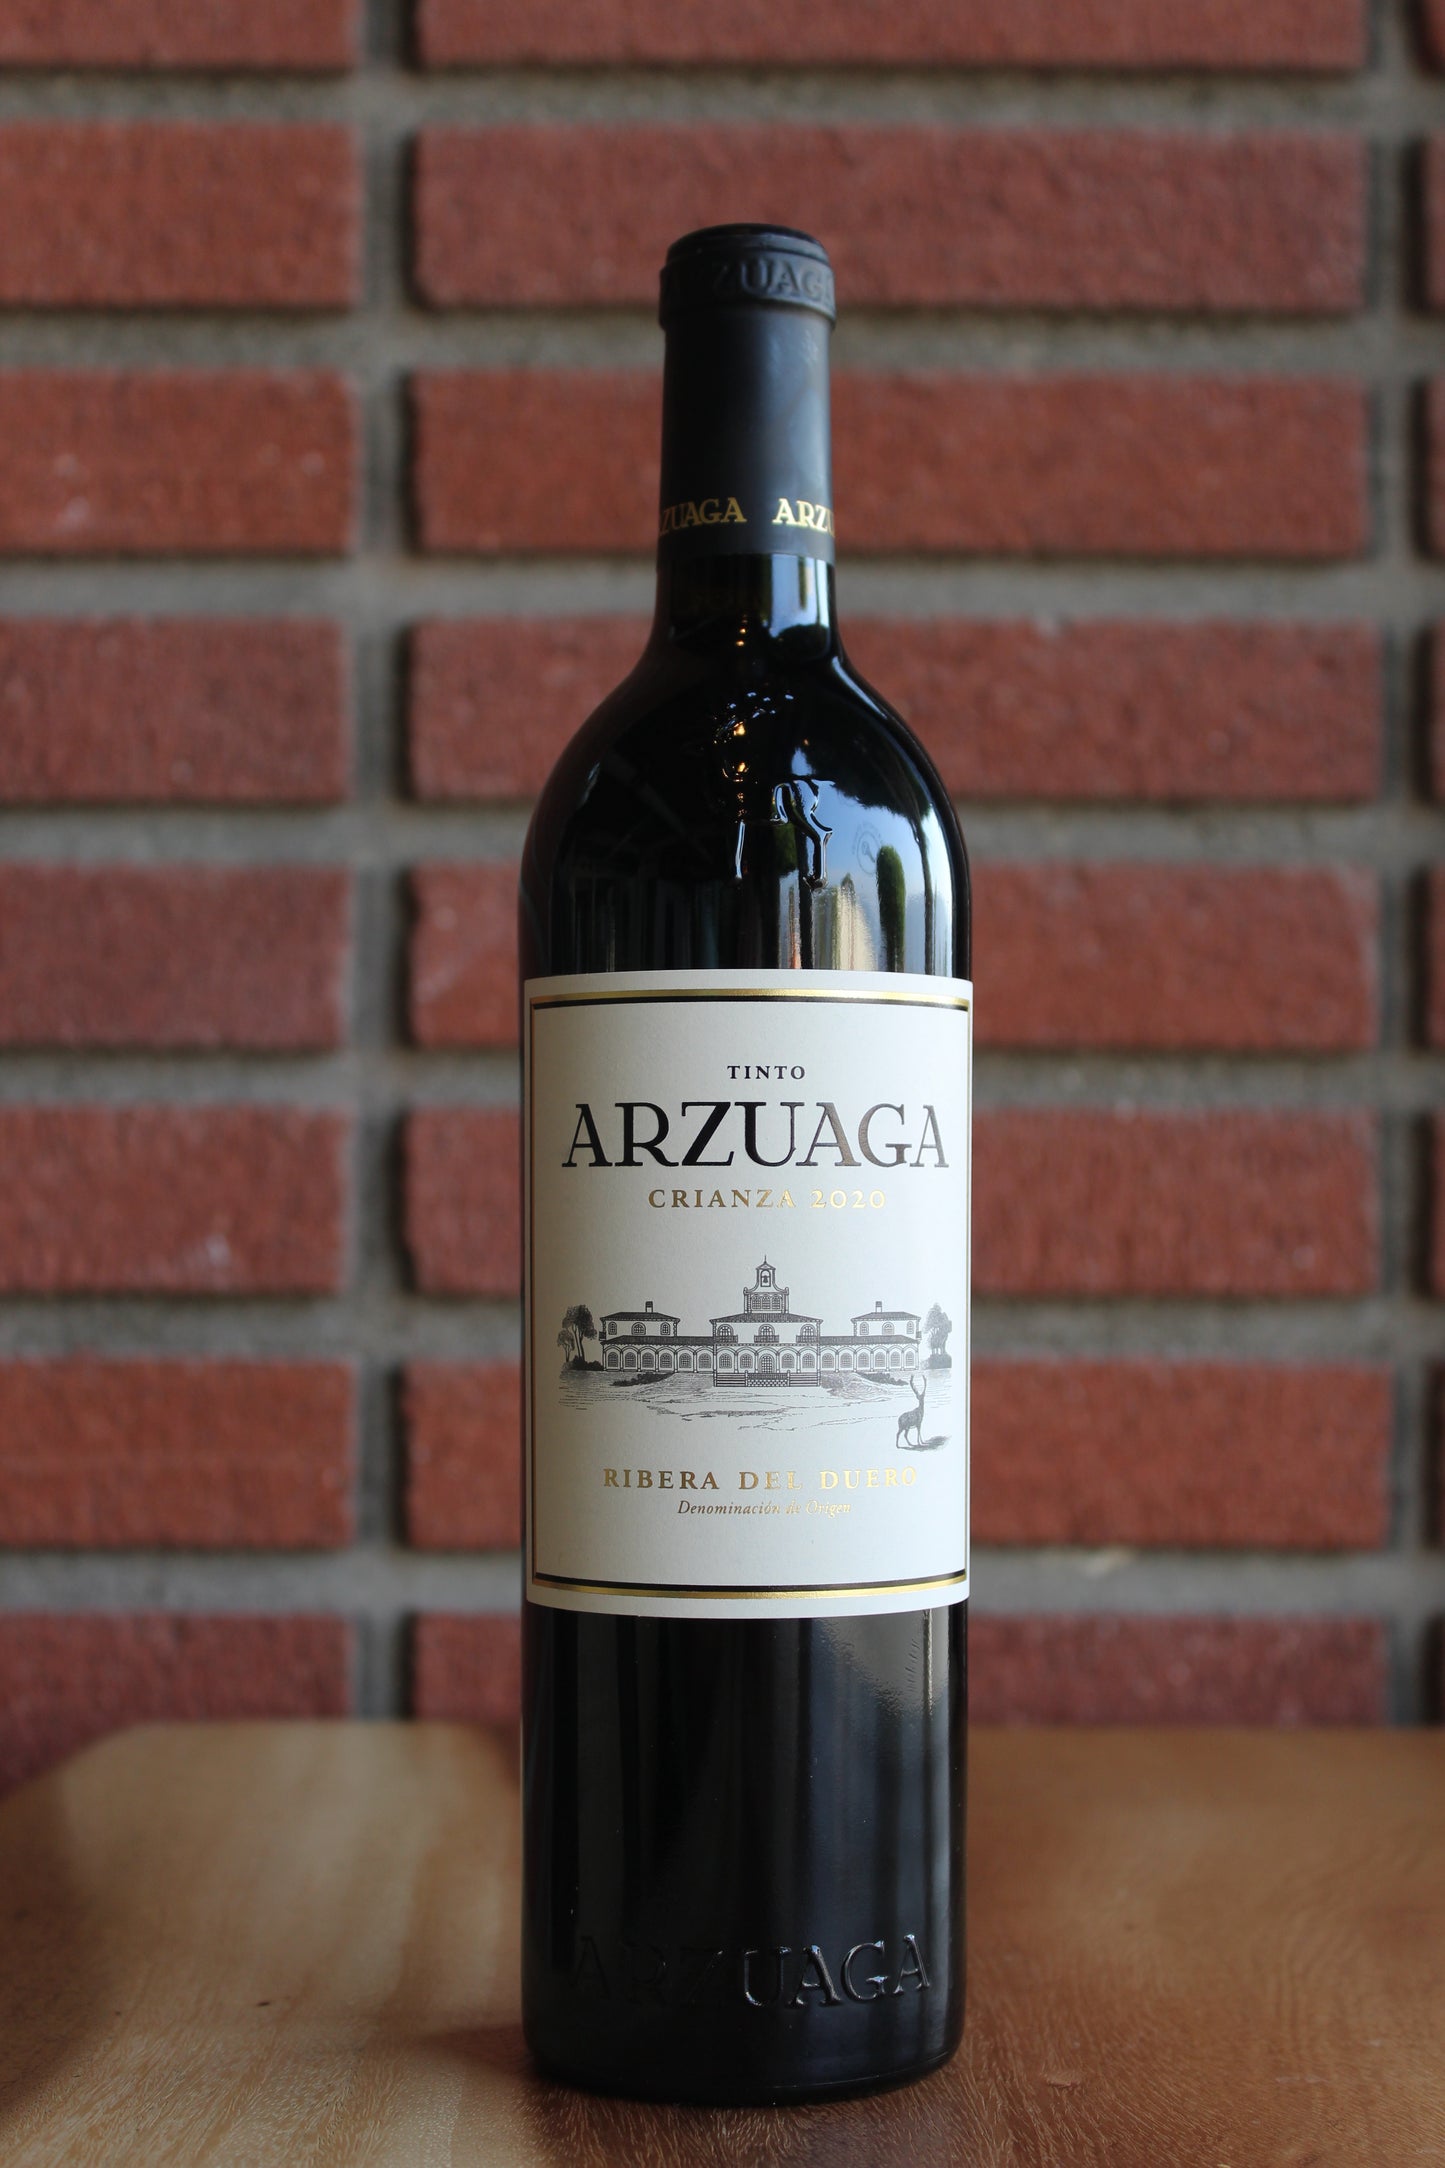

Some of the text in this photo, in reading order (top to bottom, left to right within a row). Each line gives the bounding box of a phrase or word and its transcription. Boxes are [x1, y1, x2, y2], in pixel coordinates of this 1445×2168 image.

[727, 1065, 806, 1080] TINTO
[561, 1101, 950, 1169] ARZUAGA
[648, 1189, 887, 1210] CRIANZA 2020
[603, 1466, 918, 1490] RIBERA DEL DUERO
[677, 1500, 852, 1519] Denominación de Origen
